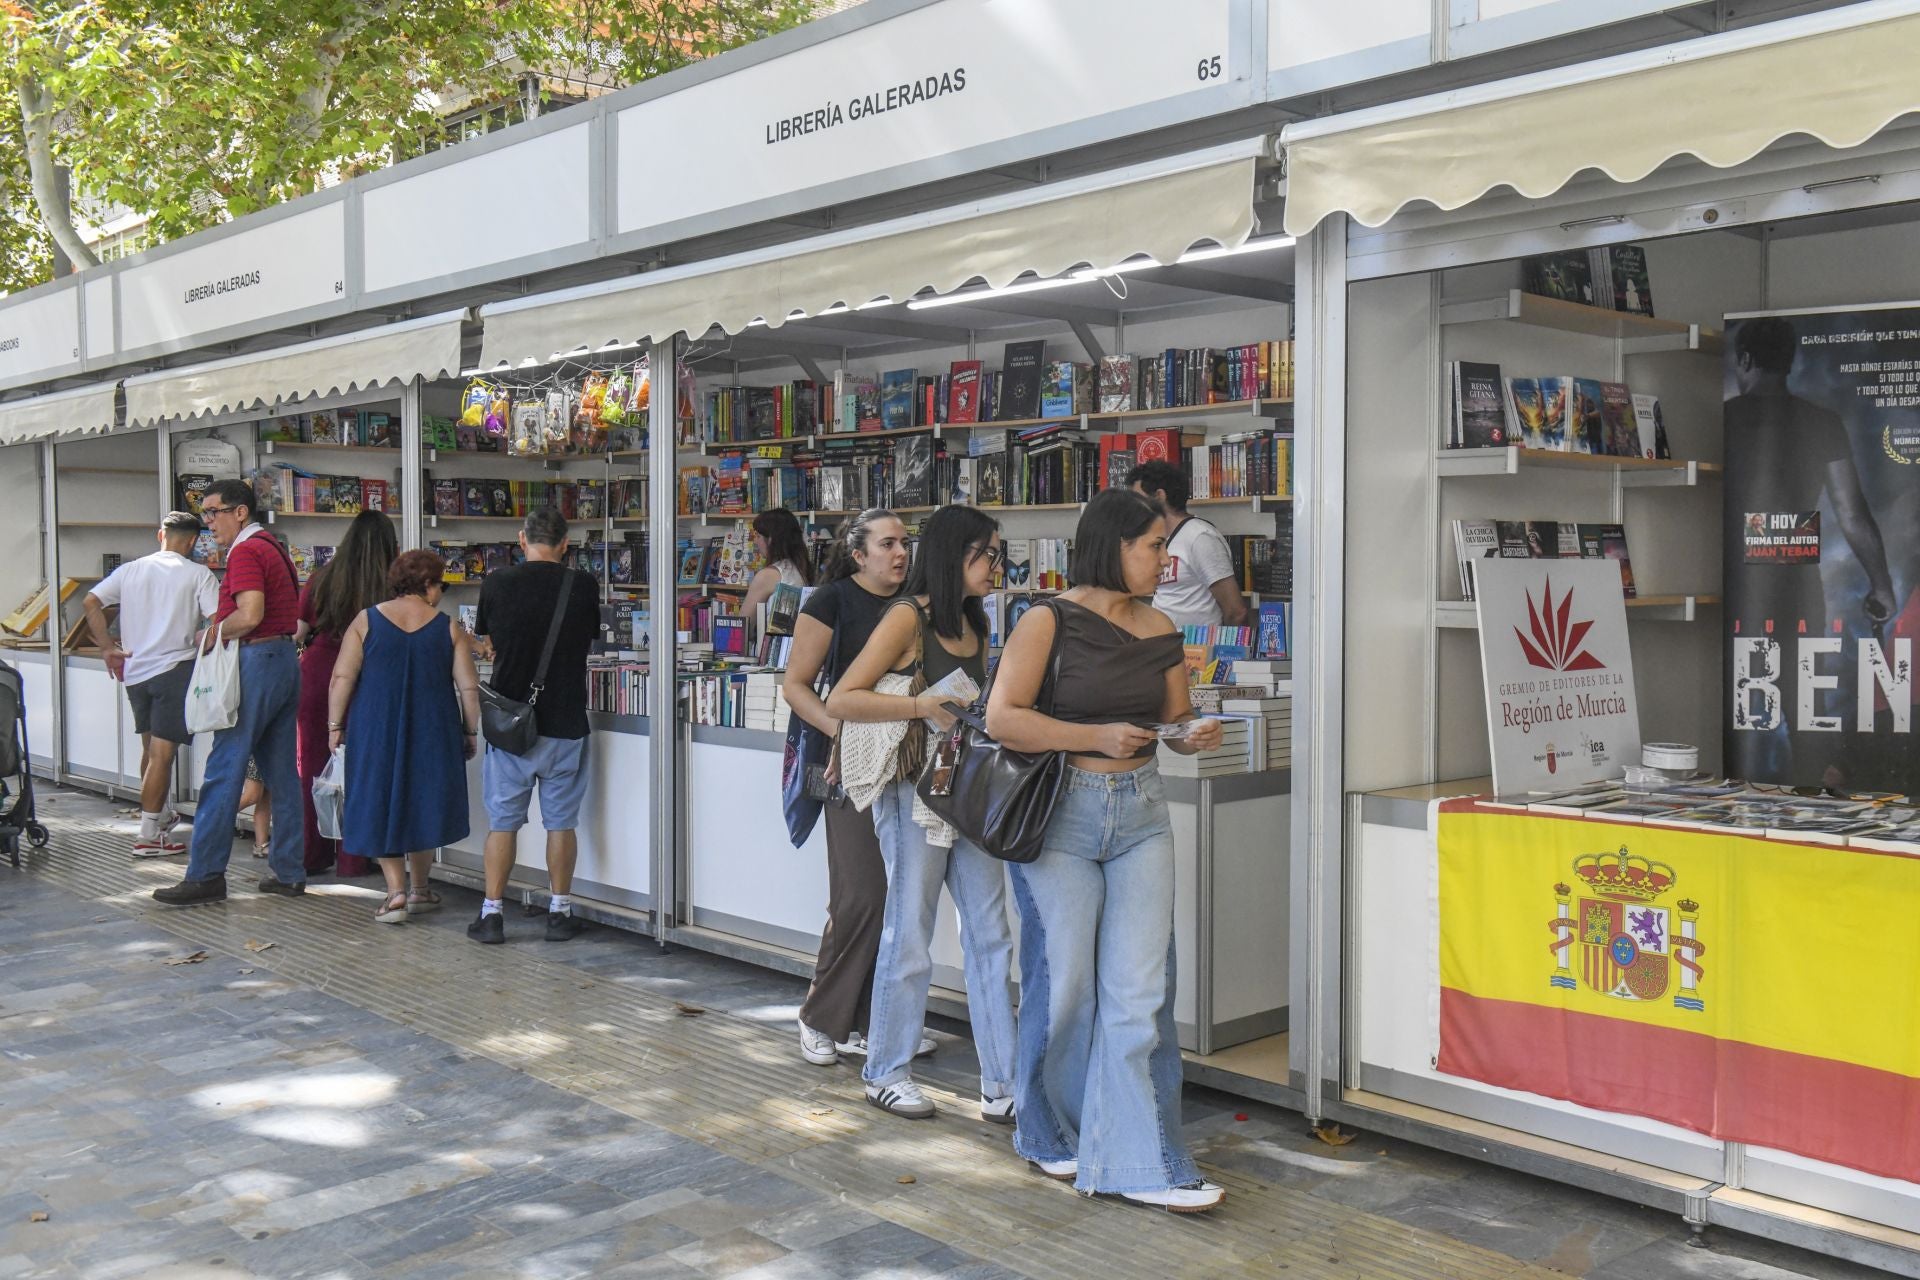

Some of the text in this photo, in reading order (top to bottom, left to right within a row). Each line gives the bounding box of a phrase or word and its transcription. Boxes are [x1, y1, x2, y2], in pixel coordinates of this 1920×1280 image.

[1198, 55, 1222, 81] 65
[766, 67, 966, 144] LIBRERÍA GALERADAS
[184, 270, 260, 304] LIBRERÍA GALERADAS
[334, 281, 343, 294] 64
[1875, 331, 1894, 341] QUE
[1840, 364, 1859, 373] HASTA
[1861, 361, 1881, 372] DÓNDE
[1883, 359, 1912, 371] ESTARÍAS
[1879, 373, 1886, 383] SI
[1887, 373, 1904, 382] TODO
[1906, 373, 1914, 382] LO
[1471, 382, 1492, 391] REINA
[1856, 386, 1861, 396] Y
[1862, 386, 1879, 395] TODO
[1880, 386, 1894, 395] POR
[1904, 384, 1918, 394] QUE
[1469, 391, 1496, 399] GITANA
[1875, 398, 1885, 407] UN
[1886, 395, 1898, 407] DÍA
[1771, 514, 1798, 530] HOY
[1473, 527, 1494, 535] CHICA
[1465, 535, 1496, 543] OLVIDADA
[1746, 535, 1819, 545] FIRMA DEL AUTOR
[1746, 546, 1818, 557] JUAN TEBAR
[1260, 614, 1281, 624] NUESTRO
[1499, 673, 1624, 697] GREMIO DE EDITORES DE LA
[1733, 637, 1912, 733] BEN
[1502, 691, 1627, 734] Región de Murcia
